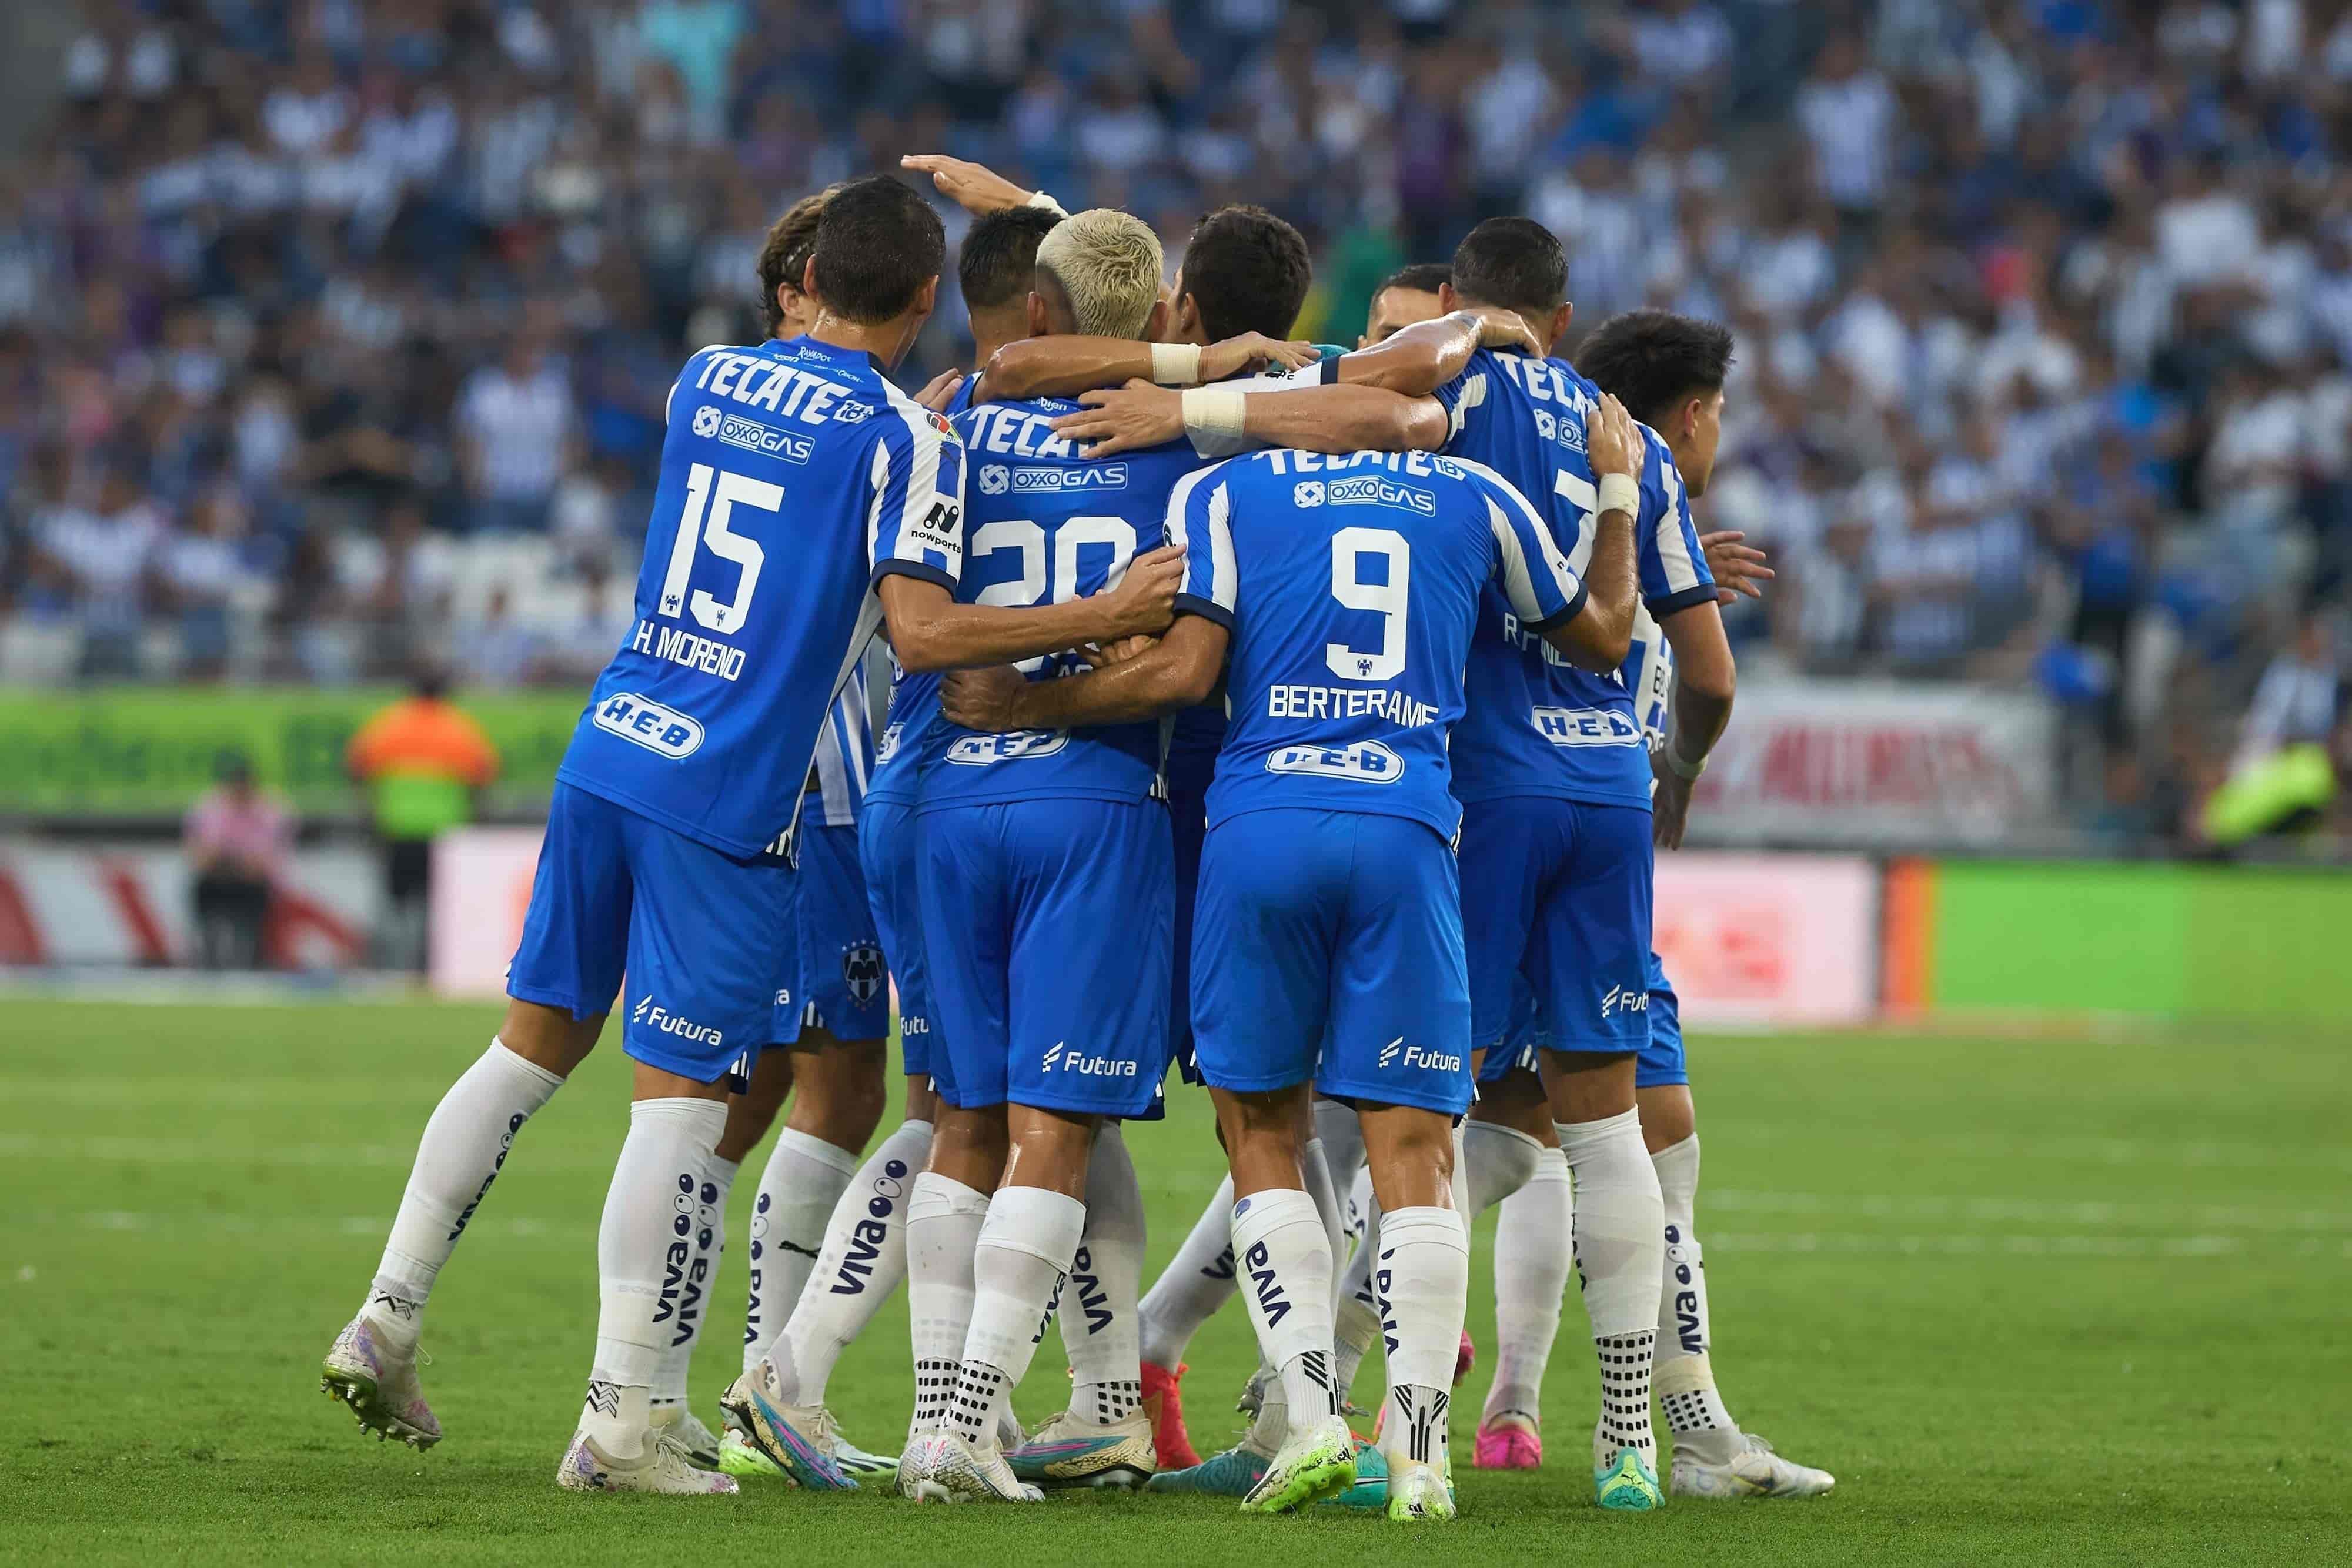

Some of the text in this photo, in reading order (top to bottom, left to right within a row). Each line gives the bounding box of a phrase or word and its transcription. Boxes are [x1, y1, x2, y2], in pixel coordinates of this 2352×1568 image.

[696, 352, 854, 425] TECATE
[1493, 352, 1599, 429] TECA
[967, 404, 1090, 459] TECA
[658, 462, 785, 635] 15
[911, 530, 961, 554] nowports
[972, 516, 1137, 664] 20
[1326, 526, 1409, 681] 9
[633, 620, 746, 682] H. MORENO
[1268, 684, 1439, 728] BERTERAME
[900, 1016, 929, 1036] Futu
[1620, 992, 1649, 1011] Fut
[647, 1006, 723, 1047] Futura
[1064, 1051, 1136, 1076] Futura
[1404, 1046, 1460, 1072] Futura
